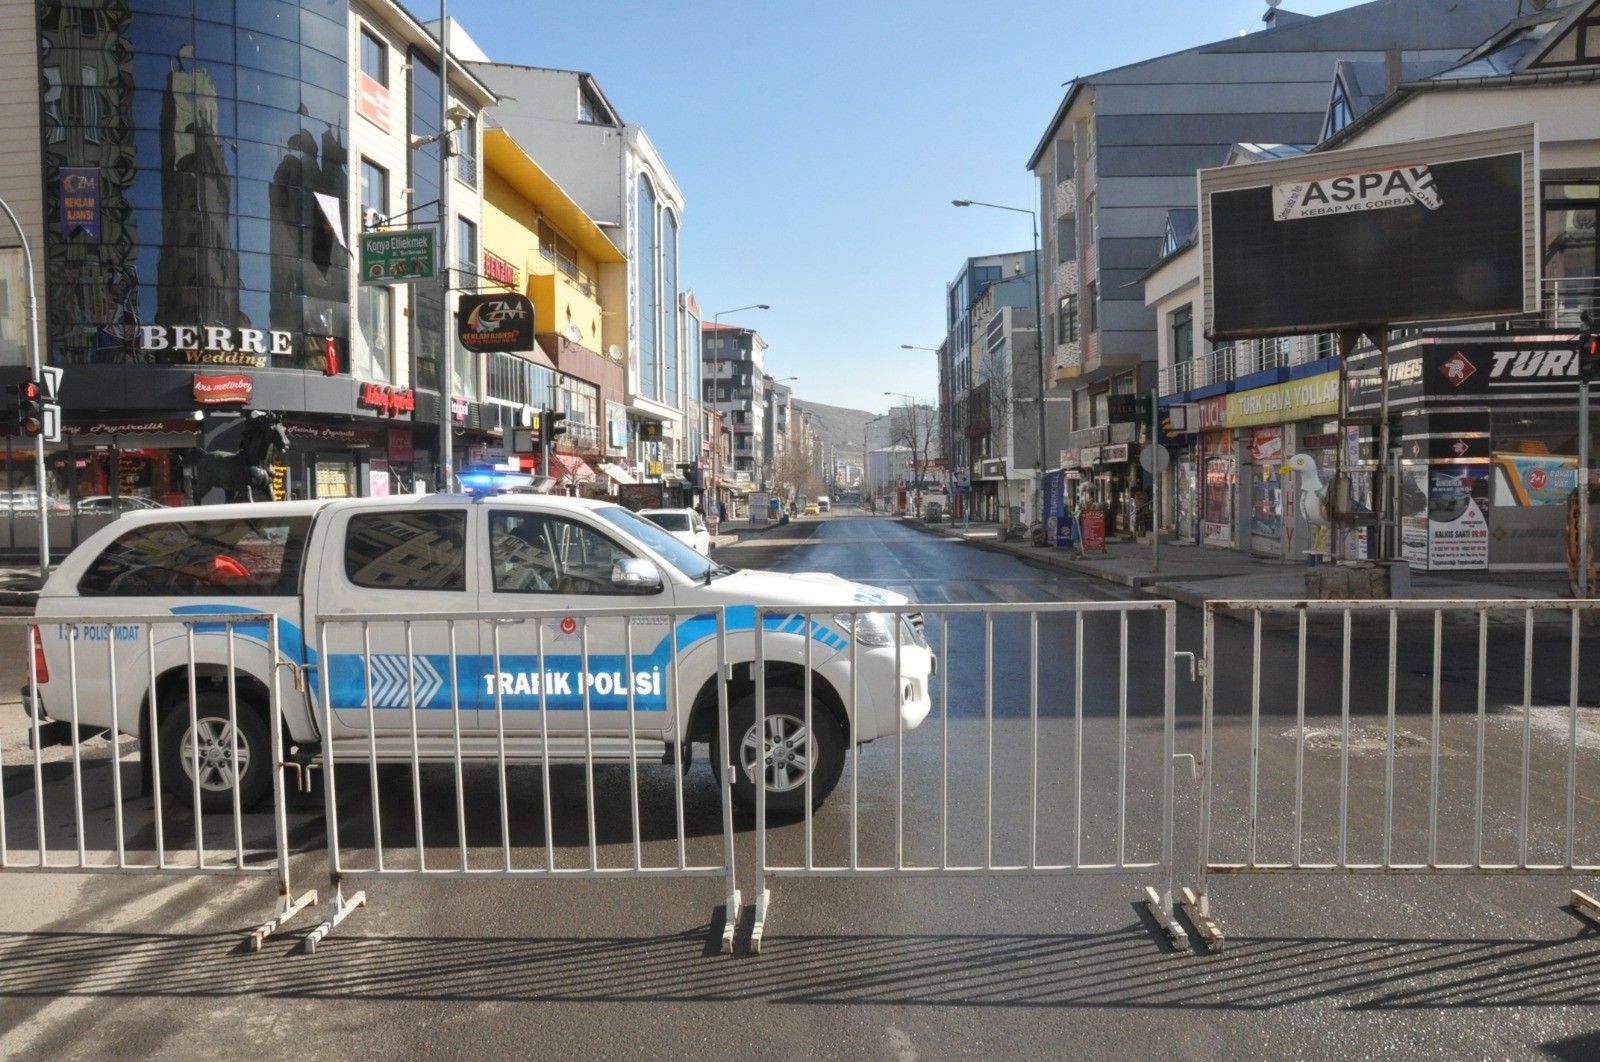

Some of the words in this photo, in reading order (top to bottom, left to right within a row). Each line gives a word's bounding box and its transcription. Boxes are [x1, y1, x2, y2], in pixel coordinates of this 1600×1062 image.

[65, 198, 94, 207] REKLAM
[1300, 206, 1343, 217] KEBAP
[1346, 203, 1362, 211] VE
[1365, 196, 1411, 210] ÇORBA
[67, 209, 93, 221] AJANSI
[366, 239, 390, 254] Konya
[390, 236, 428, 249] Etliekmek
[486, 301, 523, 320] ZM
[140, 325, 292, 354] BERRE
[186, 351, 267, 367] Wedding
[213, 379, 253, 392] metinbey
[1239, 394, 1262, 416] TÜRK
[1265, 390, 1292, 411] HAVA
[90, 422, 164, 433] Peynircilik
[1529, 473, 1546, 484] 2+1
